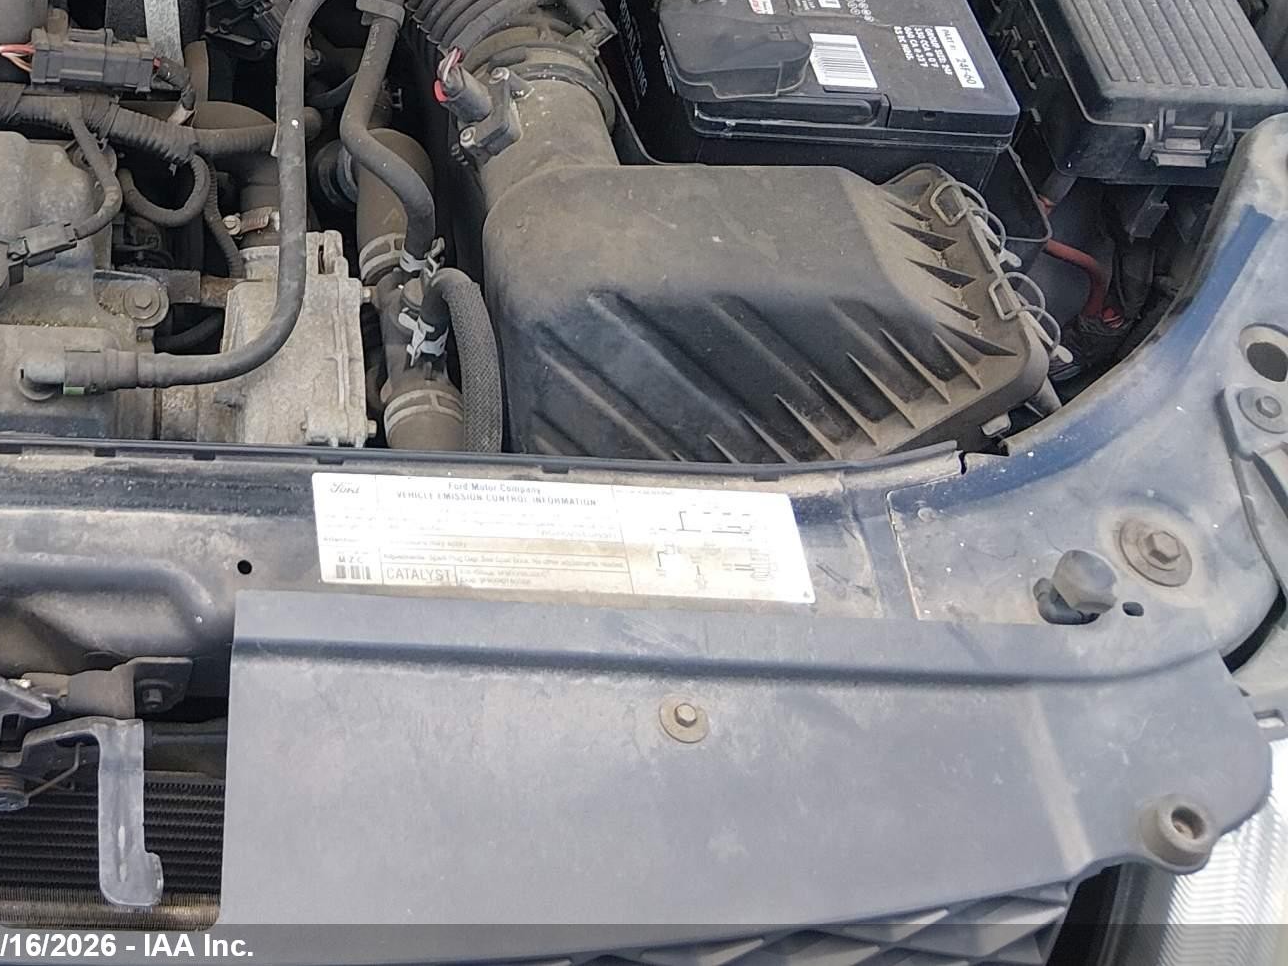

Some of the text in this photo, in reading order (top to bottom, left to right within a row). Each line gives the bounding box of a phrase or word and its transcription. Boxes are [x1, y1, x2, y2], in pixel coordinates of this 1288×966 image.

[925, 28, 940, 49] GROUP
[955, 58, 977, 85] 24F-60
[448, 482, 541, 495] Ford Motor Company
[397, 491, 597, 506] VEHICLE EMISSION CONTROL INFORMATION
[386, 566, 451, 582] CATALYST
